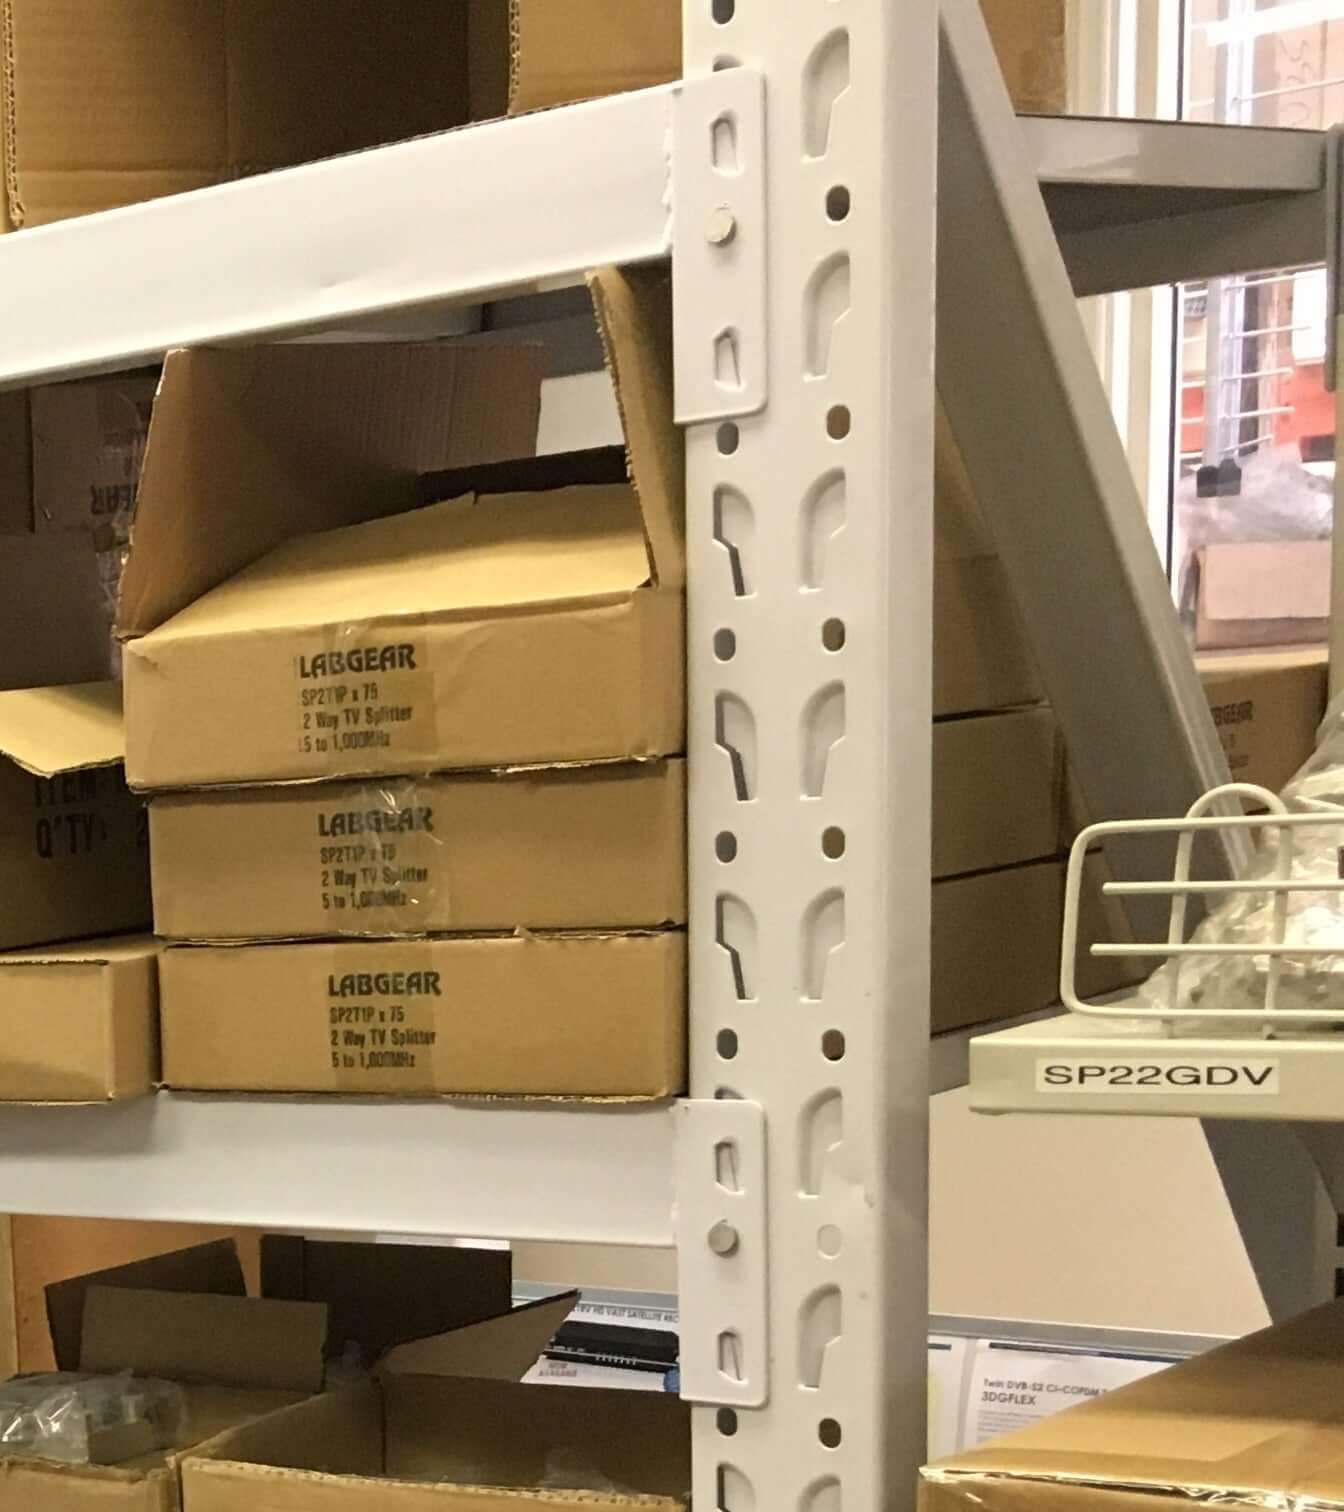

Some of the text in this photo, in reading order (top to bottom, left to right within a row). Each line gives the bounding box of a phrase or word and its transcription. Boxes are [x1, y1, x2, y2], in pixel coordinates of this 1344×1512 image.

[300, 643, 416, 679] LABGEAR
[343, 706, 413, 726] TV Splitter
[319, 807, 434, 837] LABGEAR
[329, 971, 442, 998] LABGEAR
[390, 1006, 404, 1022] 75
[343, 1028, 436, 1049] Way TV Splitter
[1044, 1064, 1275, 1088] SP22GDV
